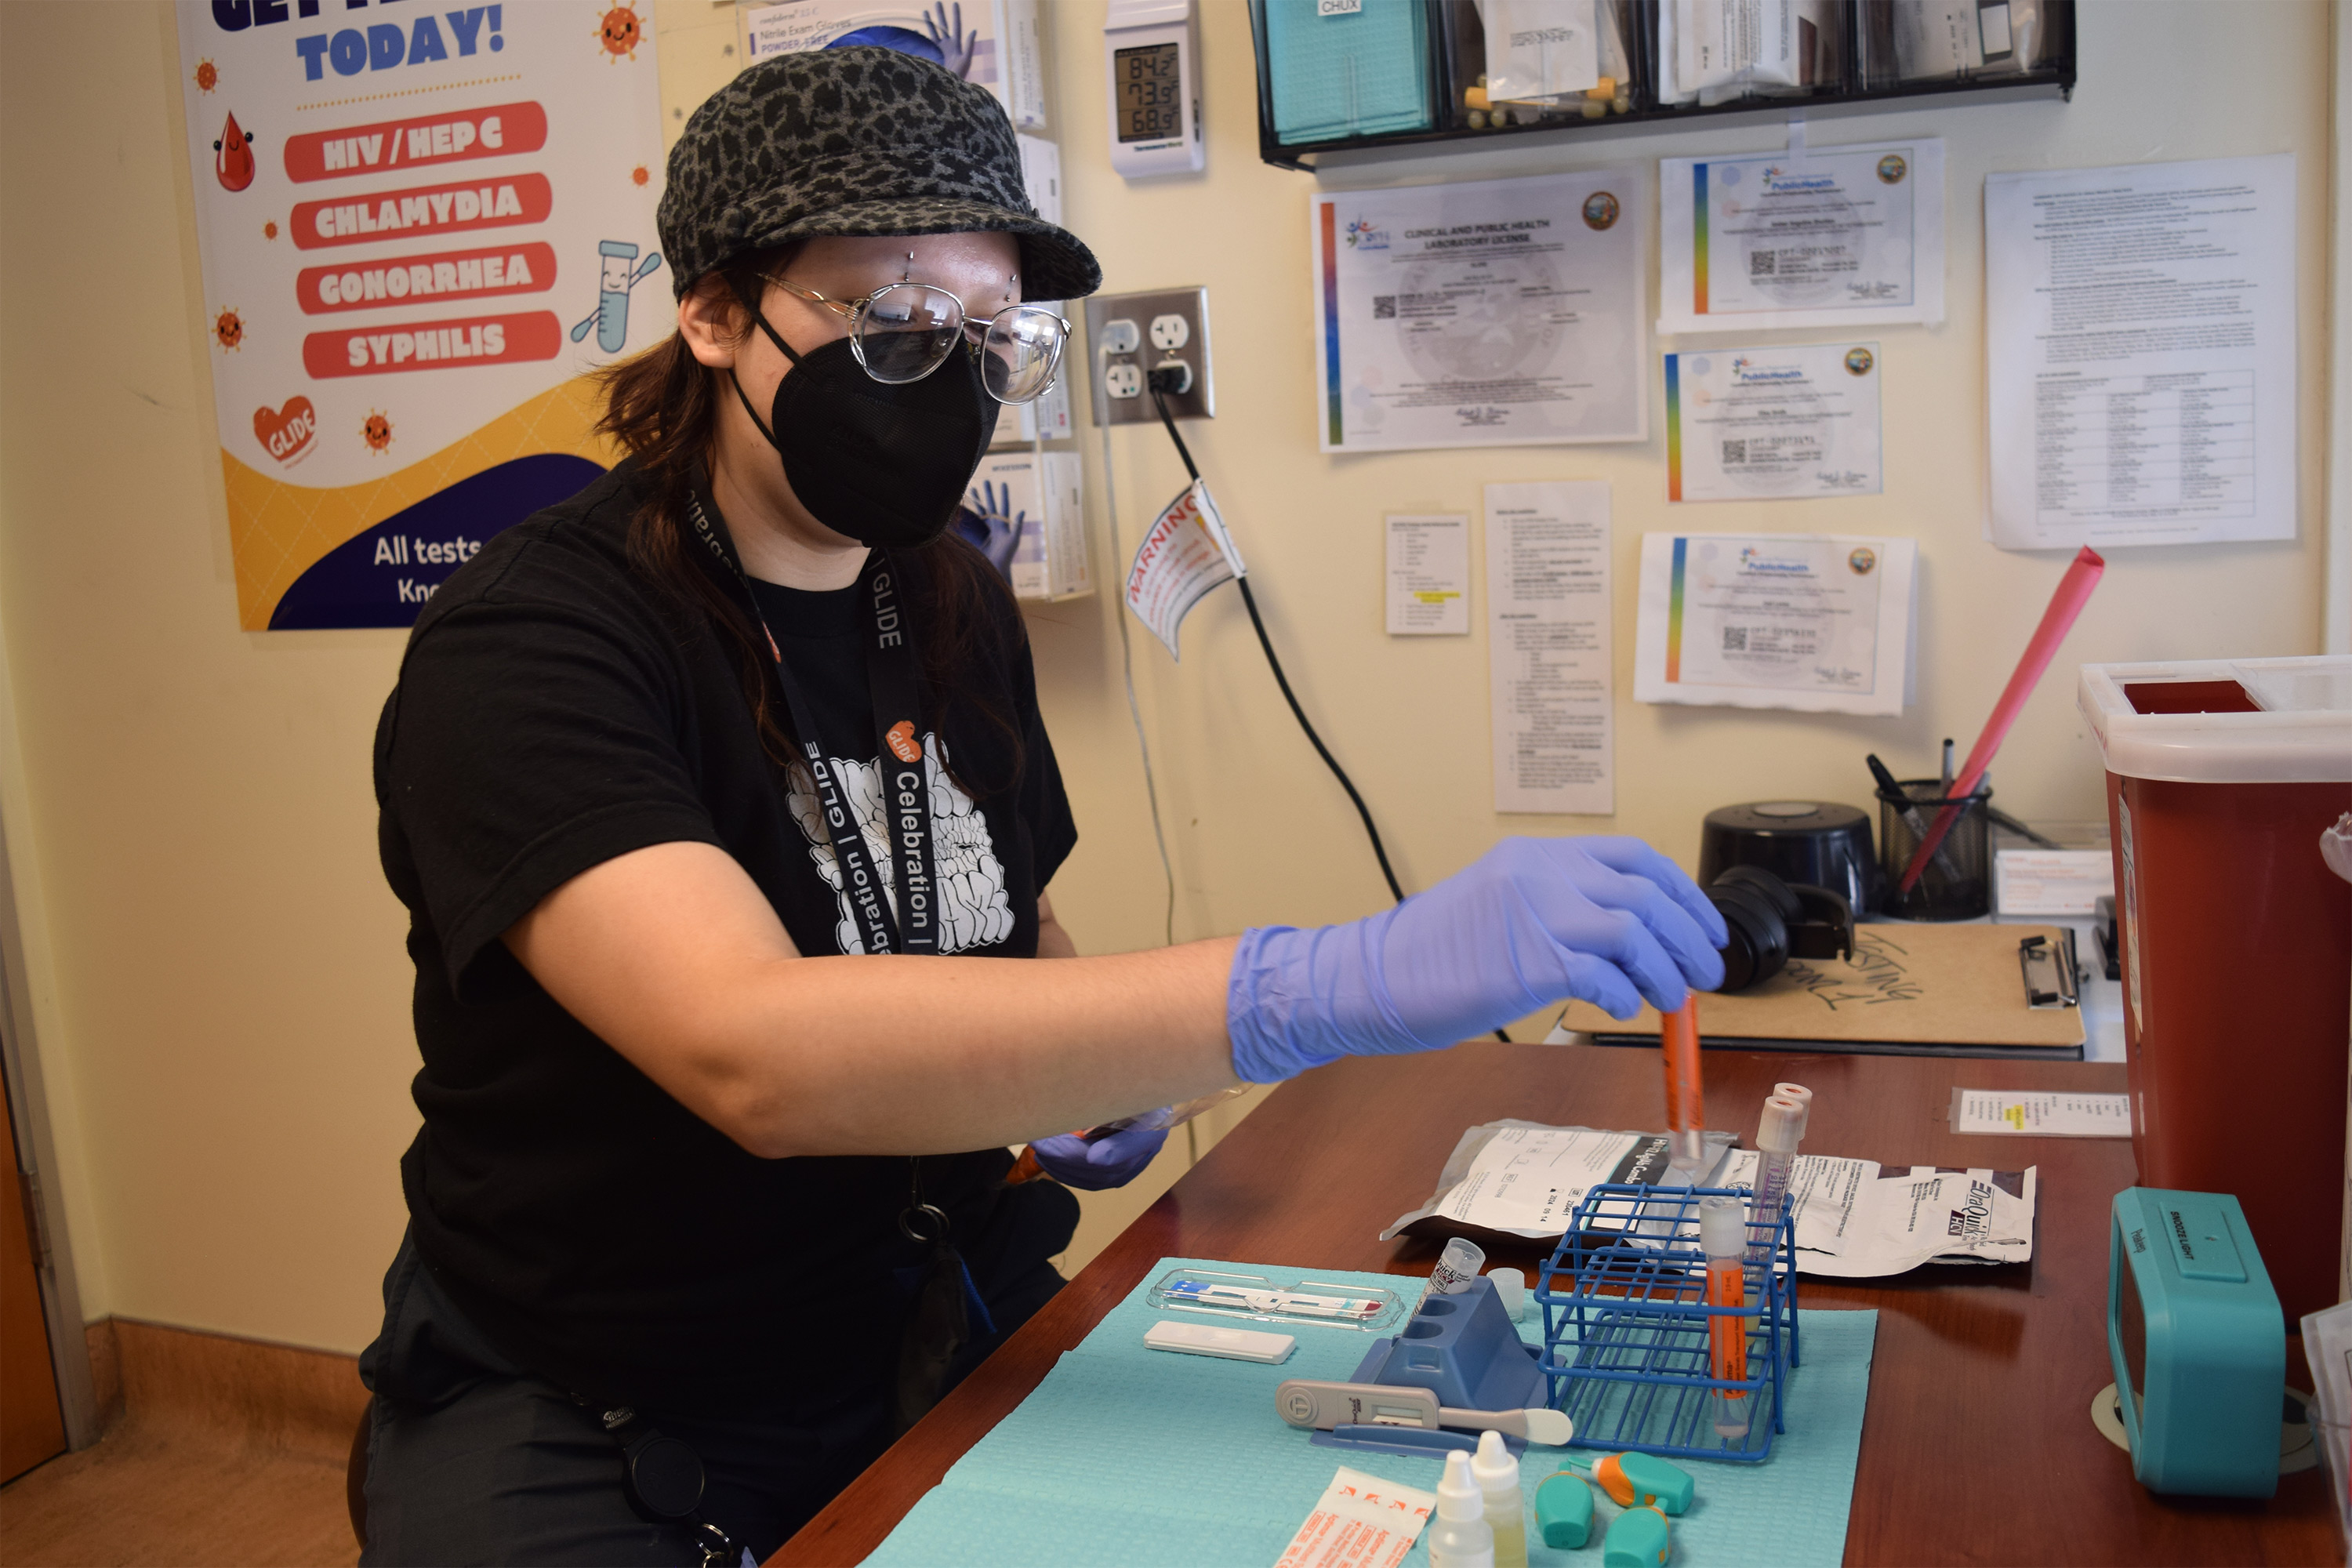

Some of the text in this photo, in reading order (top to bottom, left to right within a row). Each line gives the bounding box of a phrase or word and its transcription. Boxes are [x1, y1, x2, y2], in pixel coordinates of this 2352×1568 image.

[760, 19, 851, 40] Nitrile Exam Gloves
[1322, 0, 1359, 13] CHUX
[296, 3, 504, 82] TODAY!
[322, 133, 383, 172] HIV
[408, 121, 477, 160] HEP
[480, 115, 504, 150] C
[314, 184, 523, 239] CHLAMYDIA
[1404, 219, 1552, 240] CLINICAL AND PUBLIC HEALTH
[1424, 233, 1531, 251] LABORATORY LICENSE
[318, 253, 533, 306] GONORRHEA
[347, 324, 506, 368] SYPHILIS
[267, 408, 315, 458] GLIDE
[373, 535, 482, 566] All tests
[871, 572, 902, 649] GLIDE
[887, 729, 916, 763] GLIDE
[805, 741, 845, 829] GLIDE
[895, 771, 931, 929] Celebration
[1624, 1165, 1647, 1185] Combo
[1949, 1216, 1964, 1234] HCV
[1961, 1188, 1991, 1236] OraQuick
[2170, 1210, 2194, 1261] SNOOZE LIGHT
[1437, 1269, 1450, 1282] HCV
